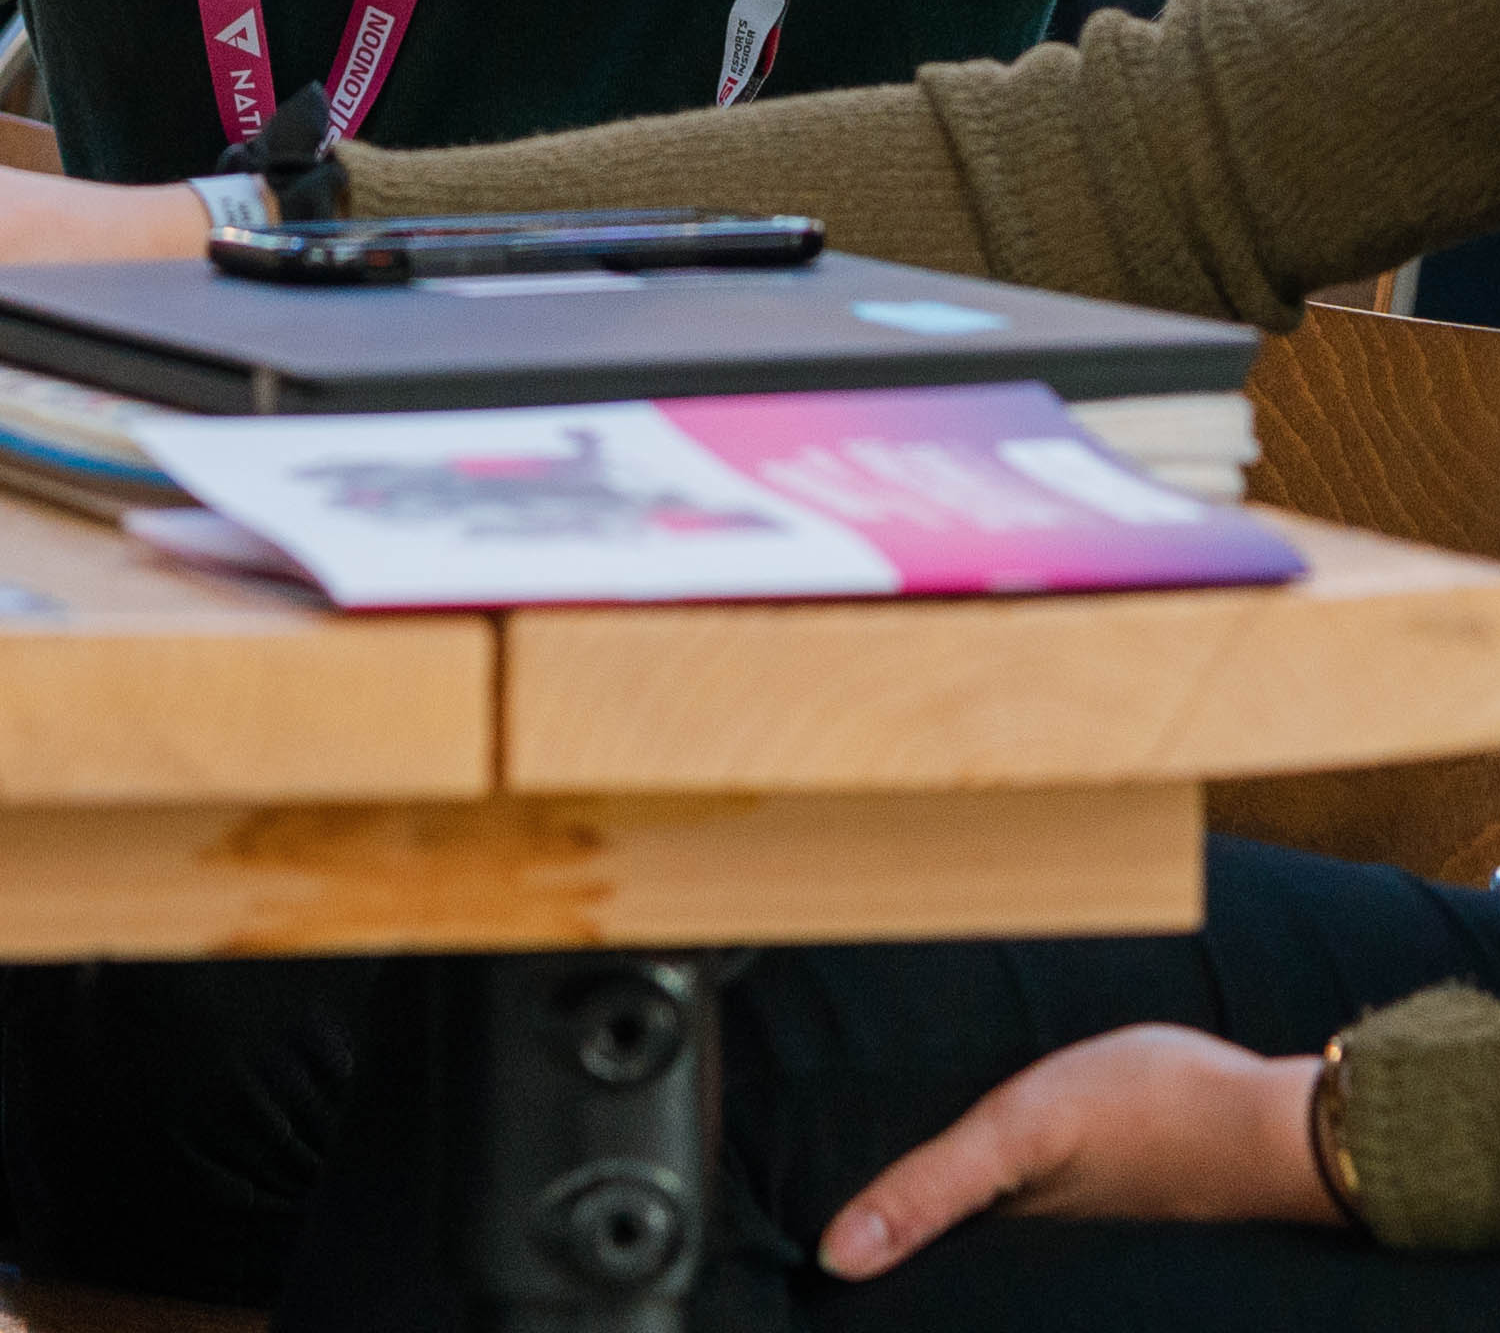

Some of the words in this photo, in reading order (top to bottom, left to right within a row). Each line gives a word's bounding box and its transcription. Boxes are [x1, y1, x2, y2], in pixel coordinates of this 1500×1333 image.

[336, 13, 388, 111] LONDON
[731, 18, 748, 74] ESPORTS
[737, 29, 756, 77] INSIDER
